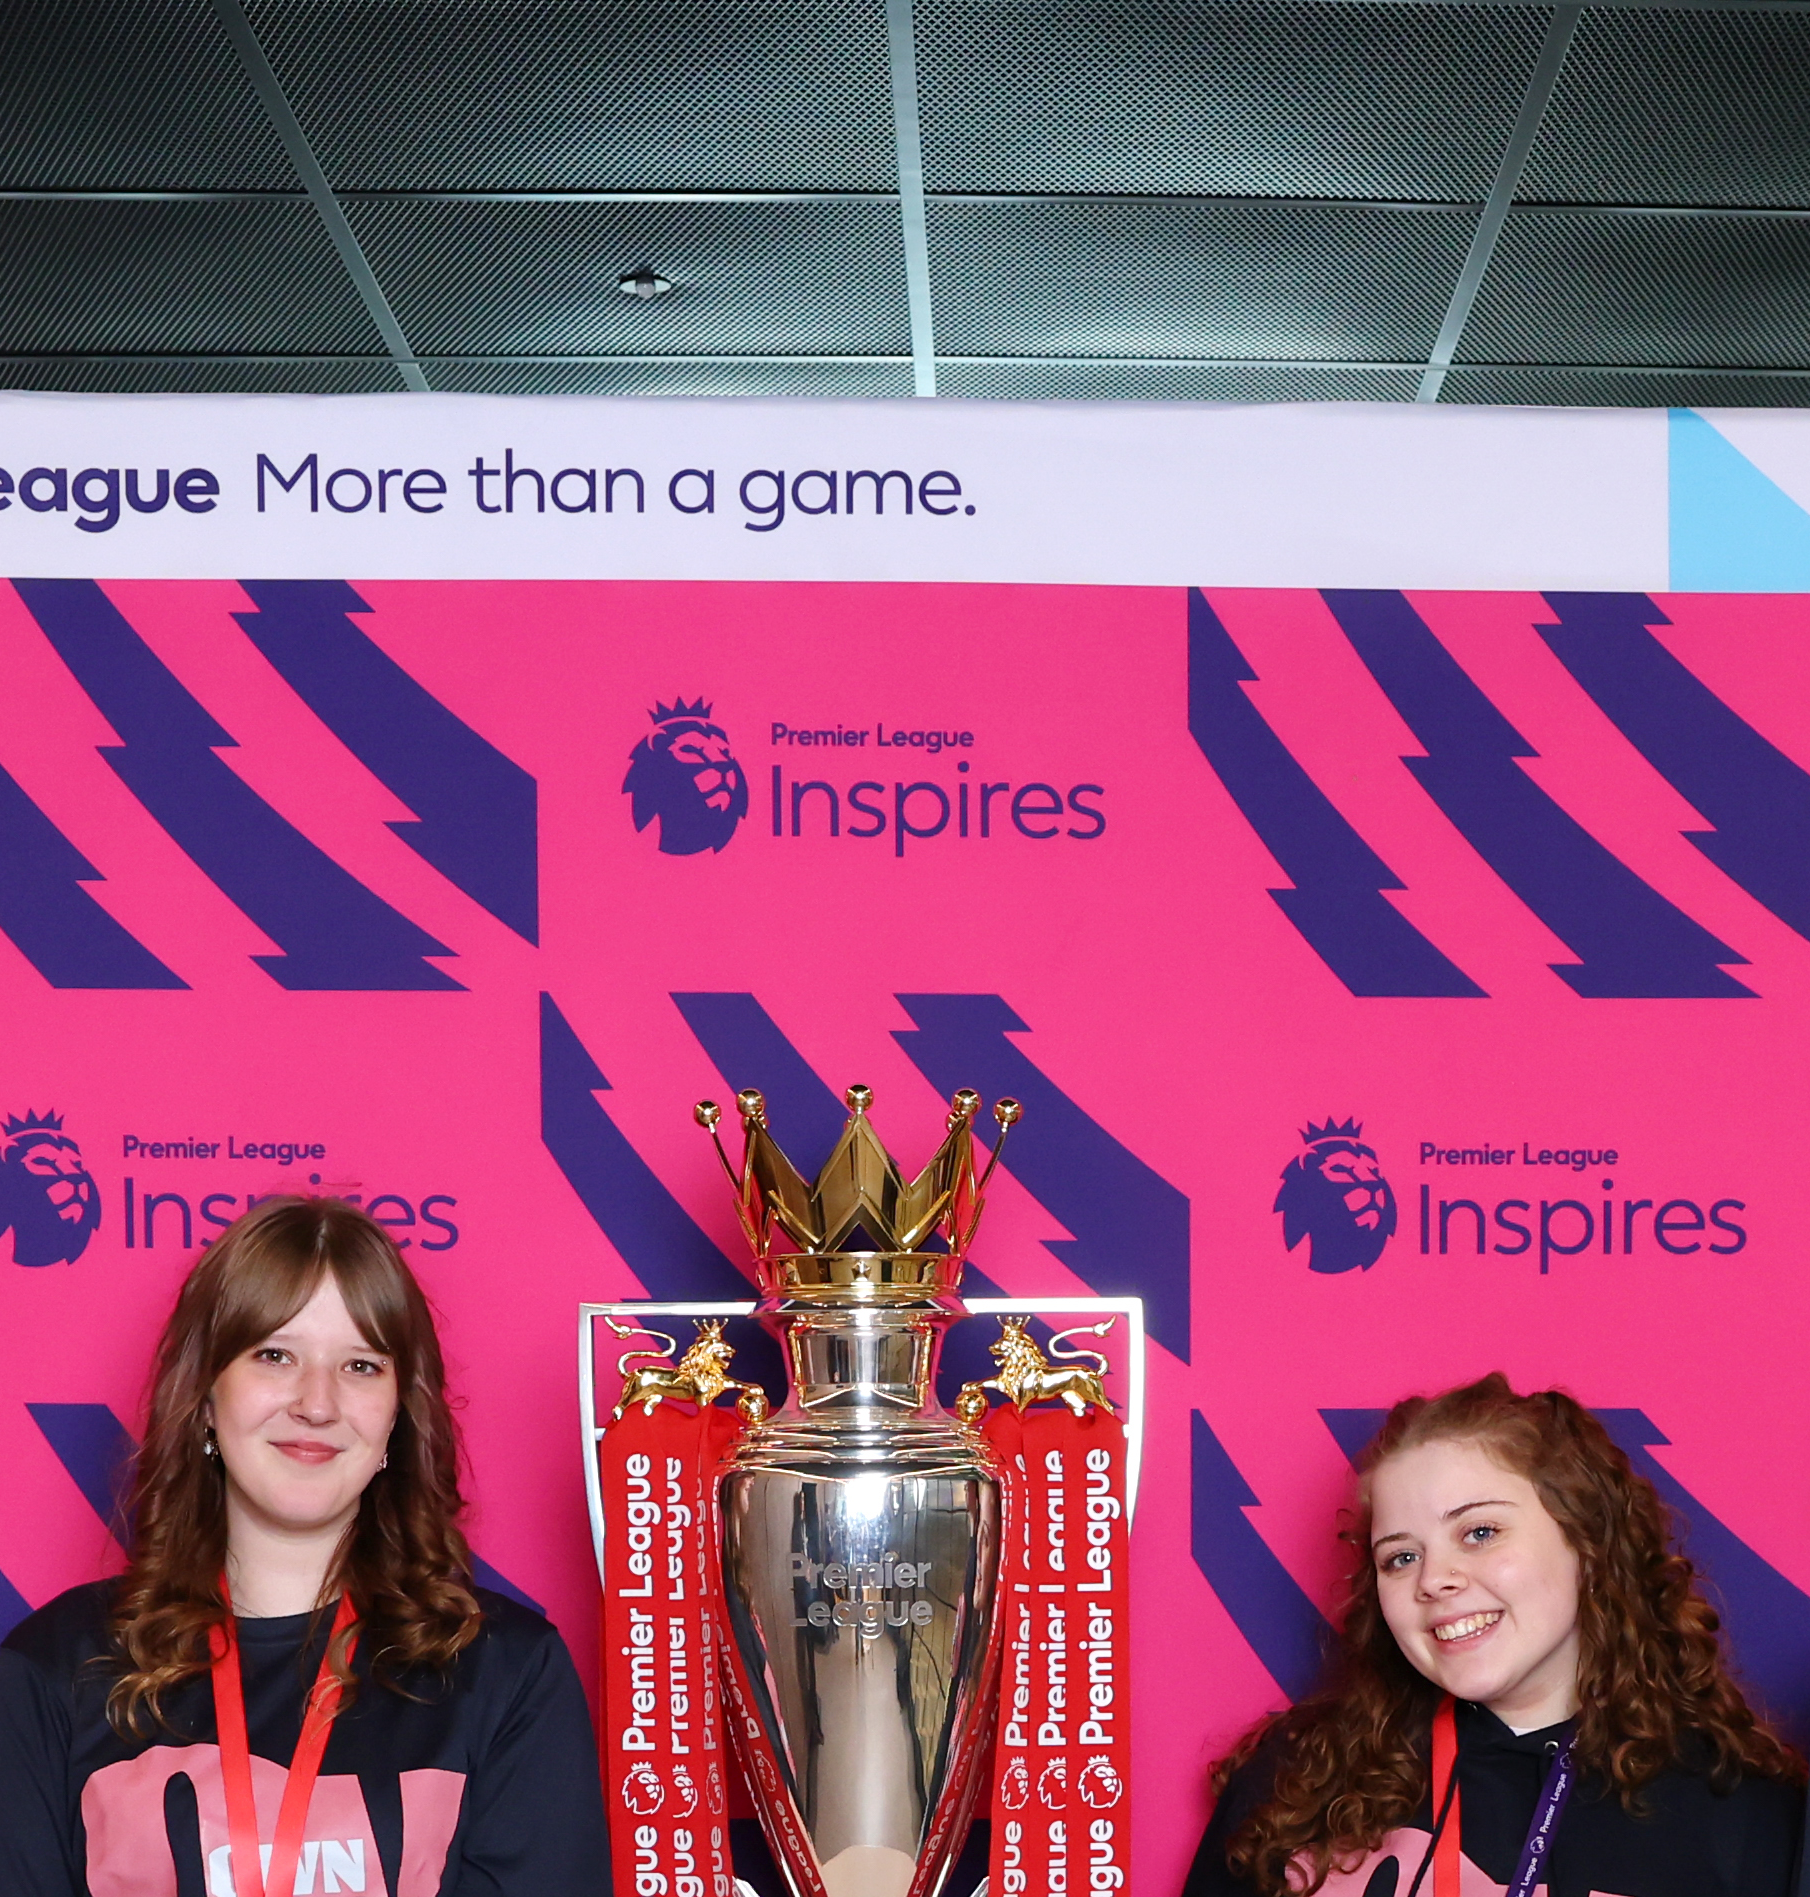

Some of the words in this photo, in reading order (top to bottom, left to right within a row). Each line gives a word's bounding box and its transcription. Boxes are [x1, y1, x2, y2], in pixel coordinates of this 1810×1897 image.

[256, 452, 447, 514] More
[468, 448, 645, 514] than
[668, 468, 715, 515] a
[739, 468, 977, 532] game.
[771, 722, 869, 747] Premier
[876, 723, 974, 753] League
[771, 760, 1107, 857] Inspires
[122, 1134, 220, 1159] Premier
[228, 1136, 326, 1165] League
[1419, 1142, 1515, 1166] Premier
[1523, 1142, 1618, 1171] League
[1419, 1178, 1747, 1275] Inspires
[619, 1453, 662, 1598] League
[1077, 1448, 1121, 1592] League
[786, 1552, 932, 1589] Premier
[789, 1600, 934, 1640] League
[621, 1607, 657, 1751] Premier
[1004, 1602, 1031, 1747] Premier
[1037, 1602, 1067, 1746] Premier
[1078, 1602, 1114, 1745] Premier
